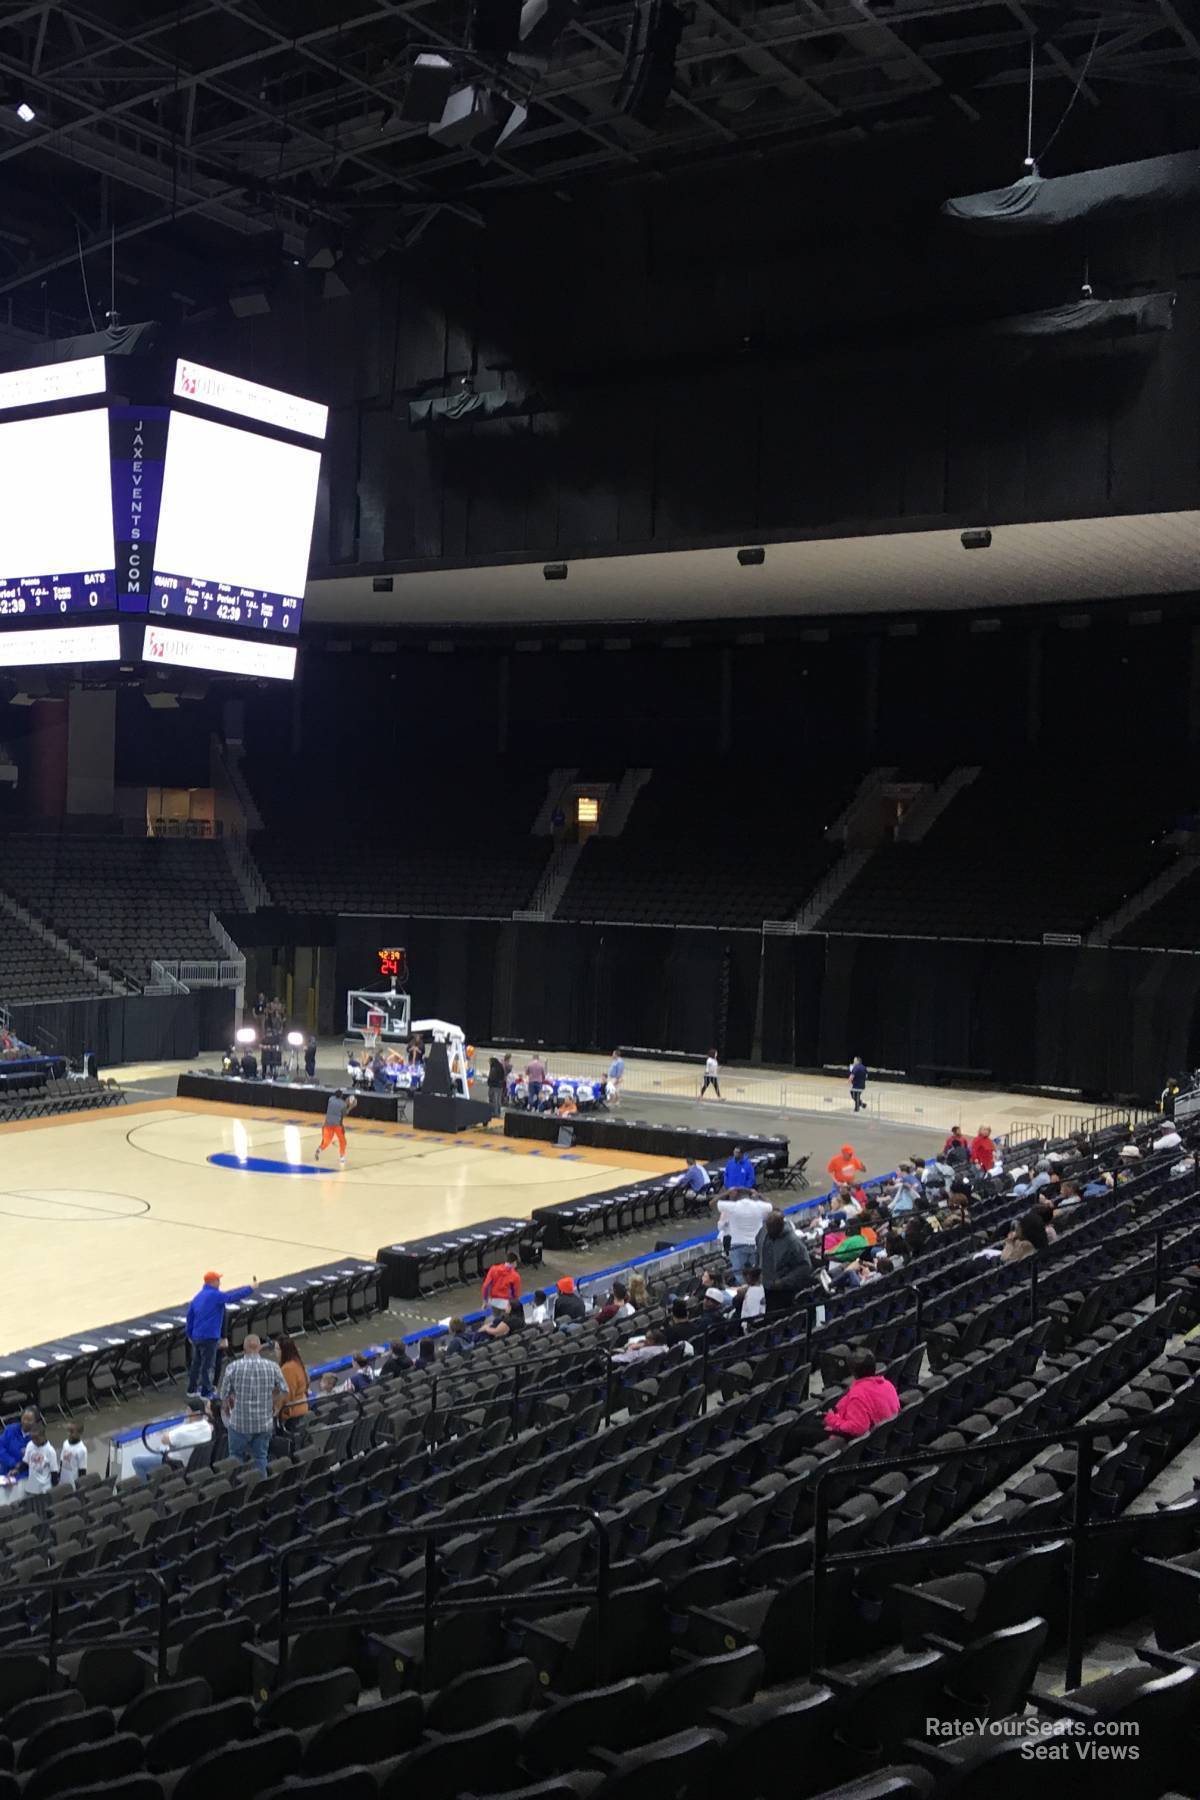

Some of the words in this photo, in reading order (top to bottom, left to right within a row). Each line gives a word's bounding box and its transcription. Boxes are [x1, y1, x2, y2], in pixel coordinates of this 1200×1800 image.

[84, 573, 106, 585] BATS
[60, 600, 67, 612] 0
[89, 591, 99, 607] 0
[161, 594, 169, 609] 0
[187, 604, 193, 616] 0
[217, 604, 241, 622] 42:39
[282, 613, 290, 628] 0
[381, 960, 397, 974] 24
